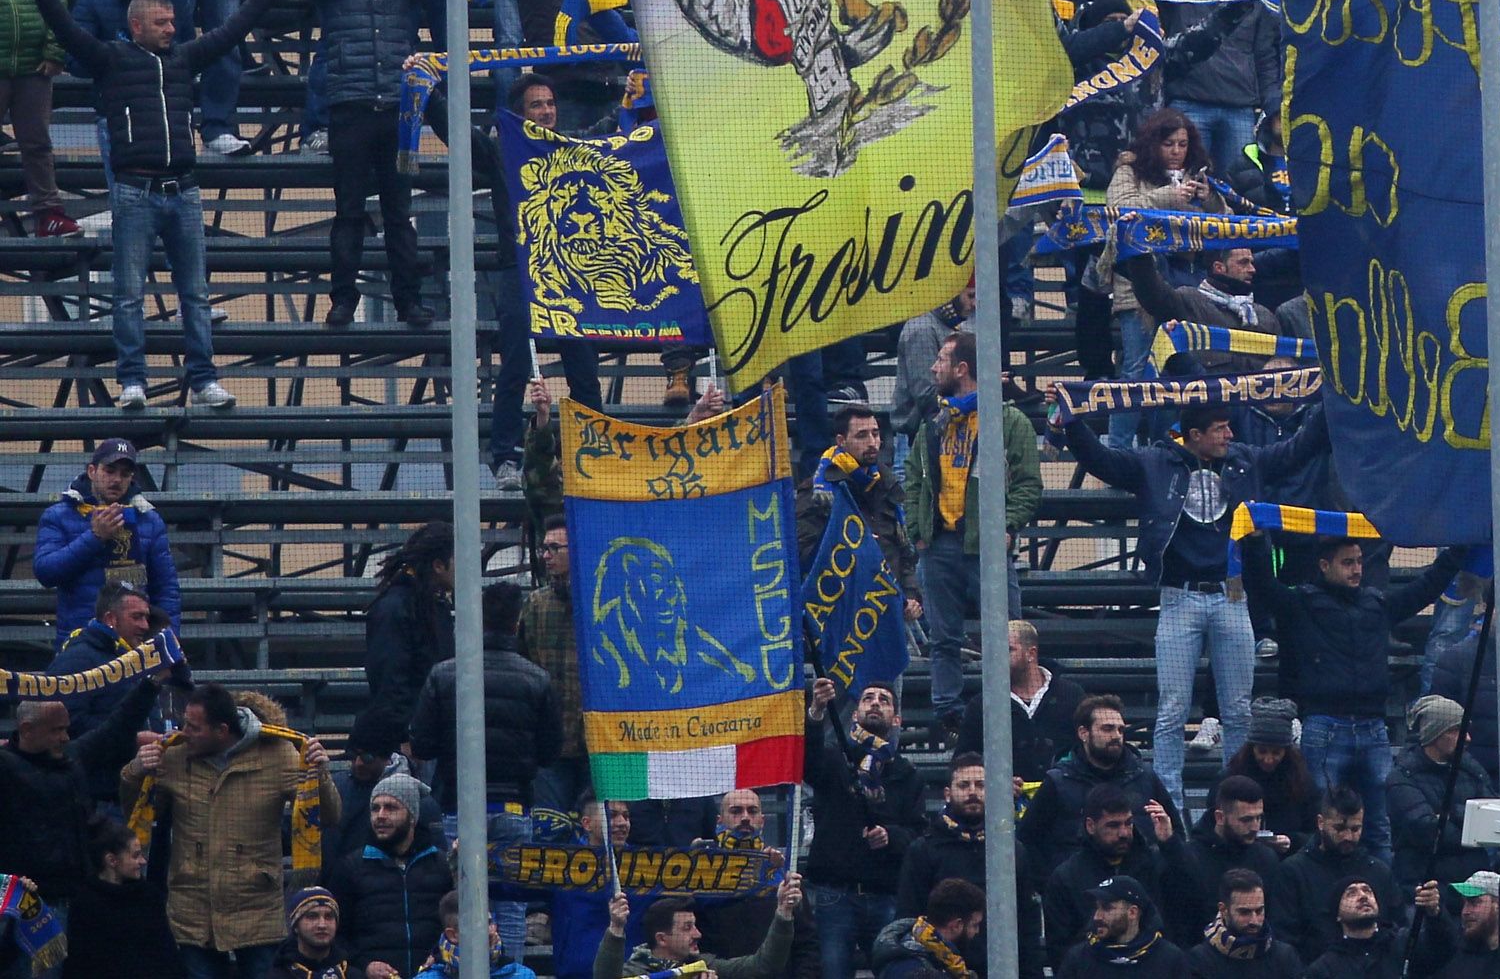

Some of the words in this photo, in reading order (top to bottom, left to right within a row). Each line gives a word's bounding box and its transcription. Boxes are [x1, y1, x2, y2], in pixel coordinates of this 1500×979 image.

[1201, 217, 1299, 240] CIOCIAR
[706, 165, 990, 376] Frosin
[531, 302, 685, 342] FREEDOM
[1056, 379, 1207, 415] LATINA
[1221, 366, 1323, 401] MERD
[574, 409, 771, 479] Brigata
[803, 514, 866, 634] ACCO
[618, 716, 660, 742] Made
[664, 720, 682, 740] in
[685, 711, 763, 737] Ciociaria
[519, 845, 748, 892] FROINONE
